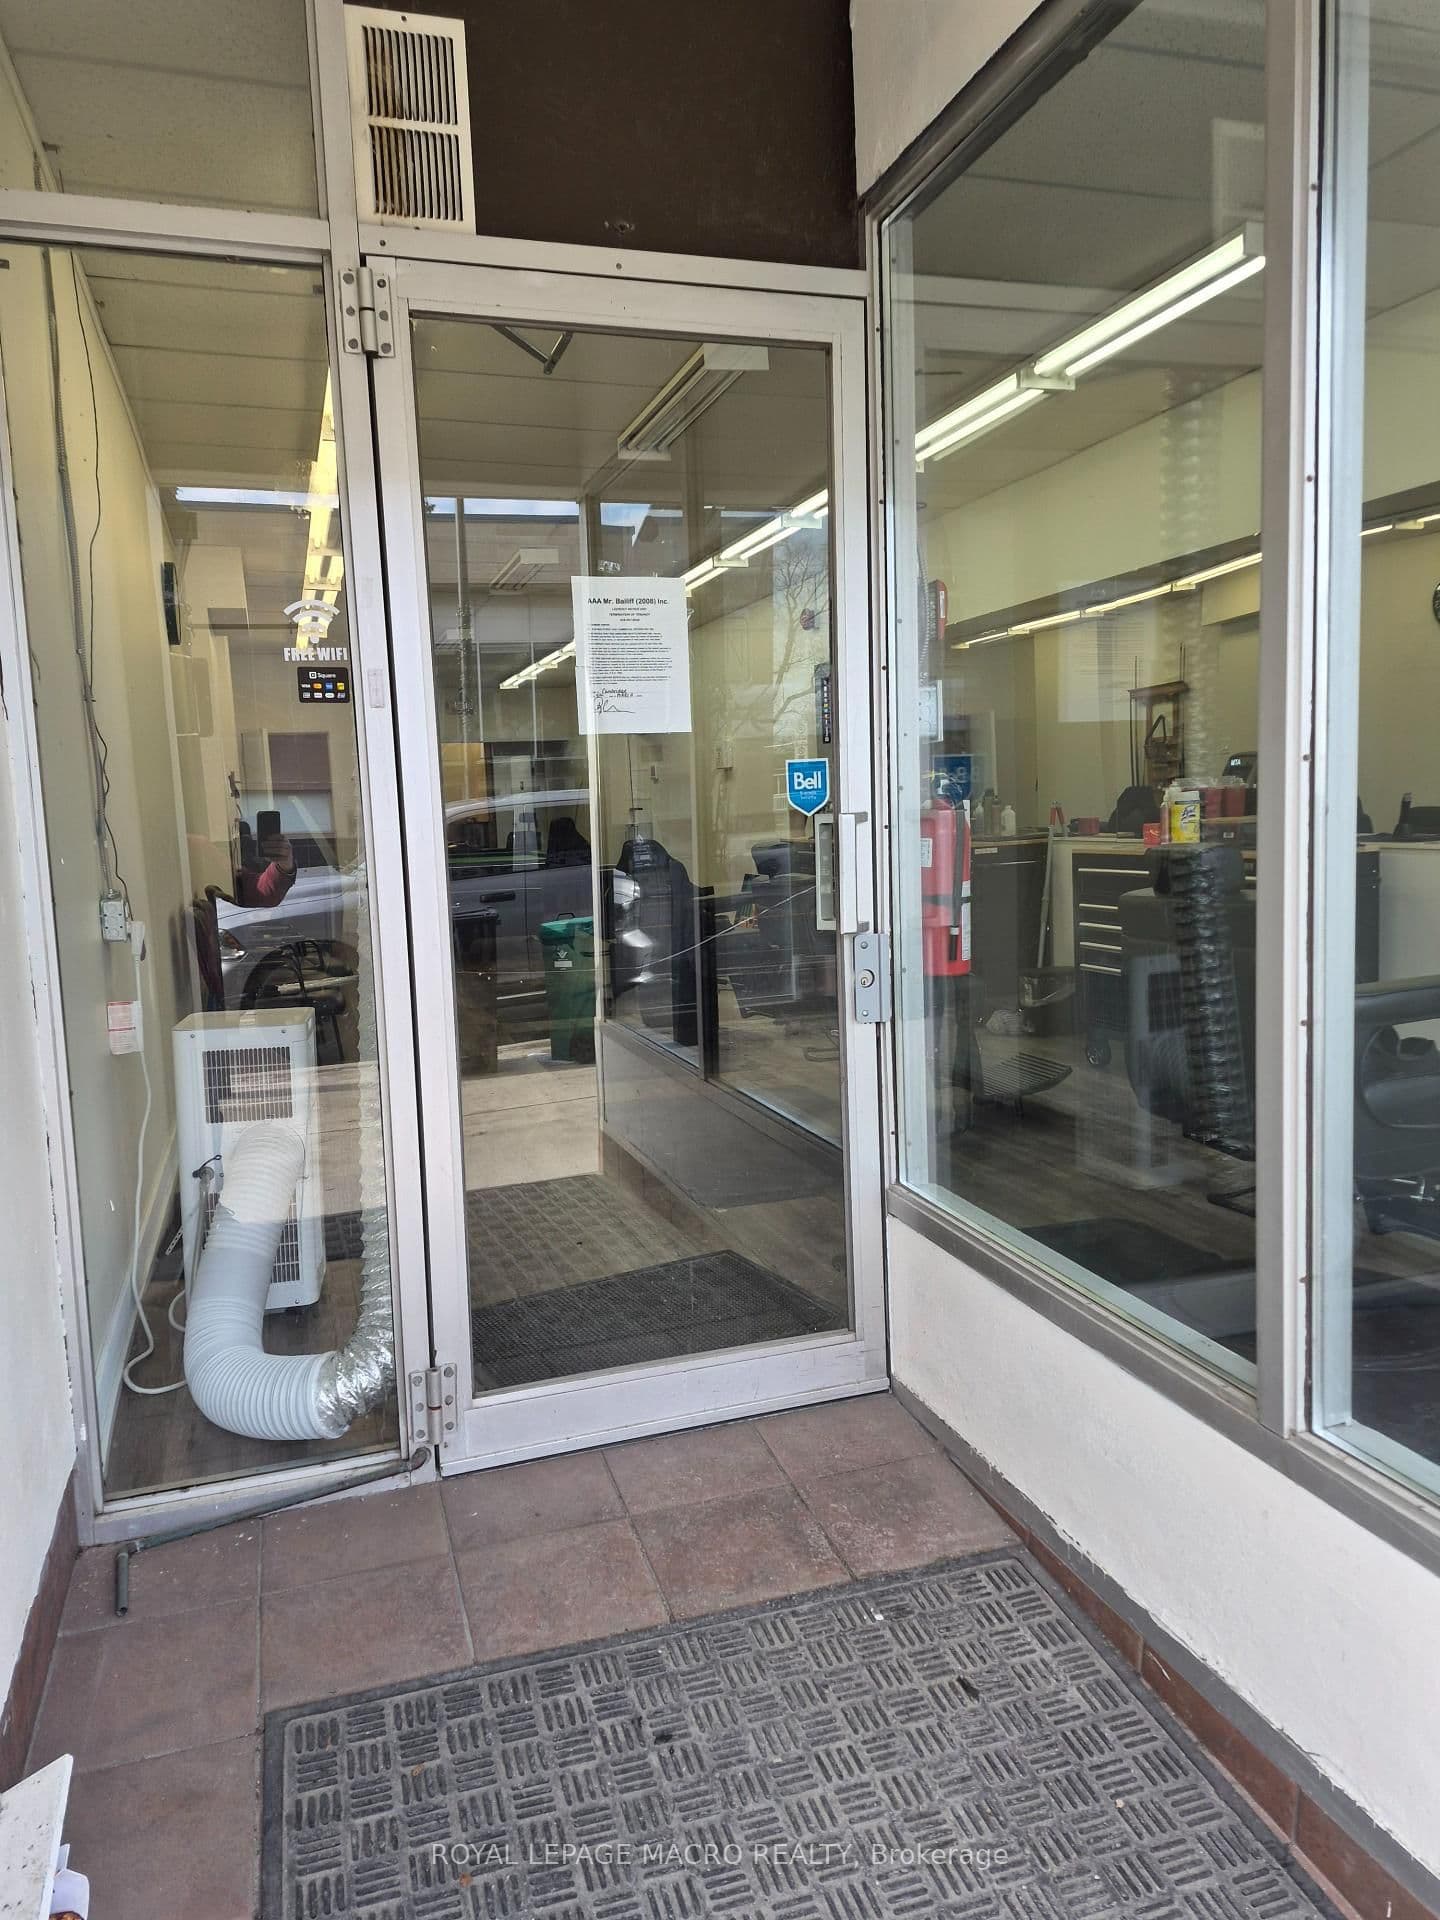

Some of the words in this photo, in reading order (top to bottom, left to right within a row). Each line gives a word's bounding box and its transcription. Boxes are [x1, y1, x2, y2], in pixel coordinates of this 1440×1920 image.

[283, 647, 315, 661] FREE
[316, 647, 348, 661] WIFI
[793, 771, 822, 790] Bell
